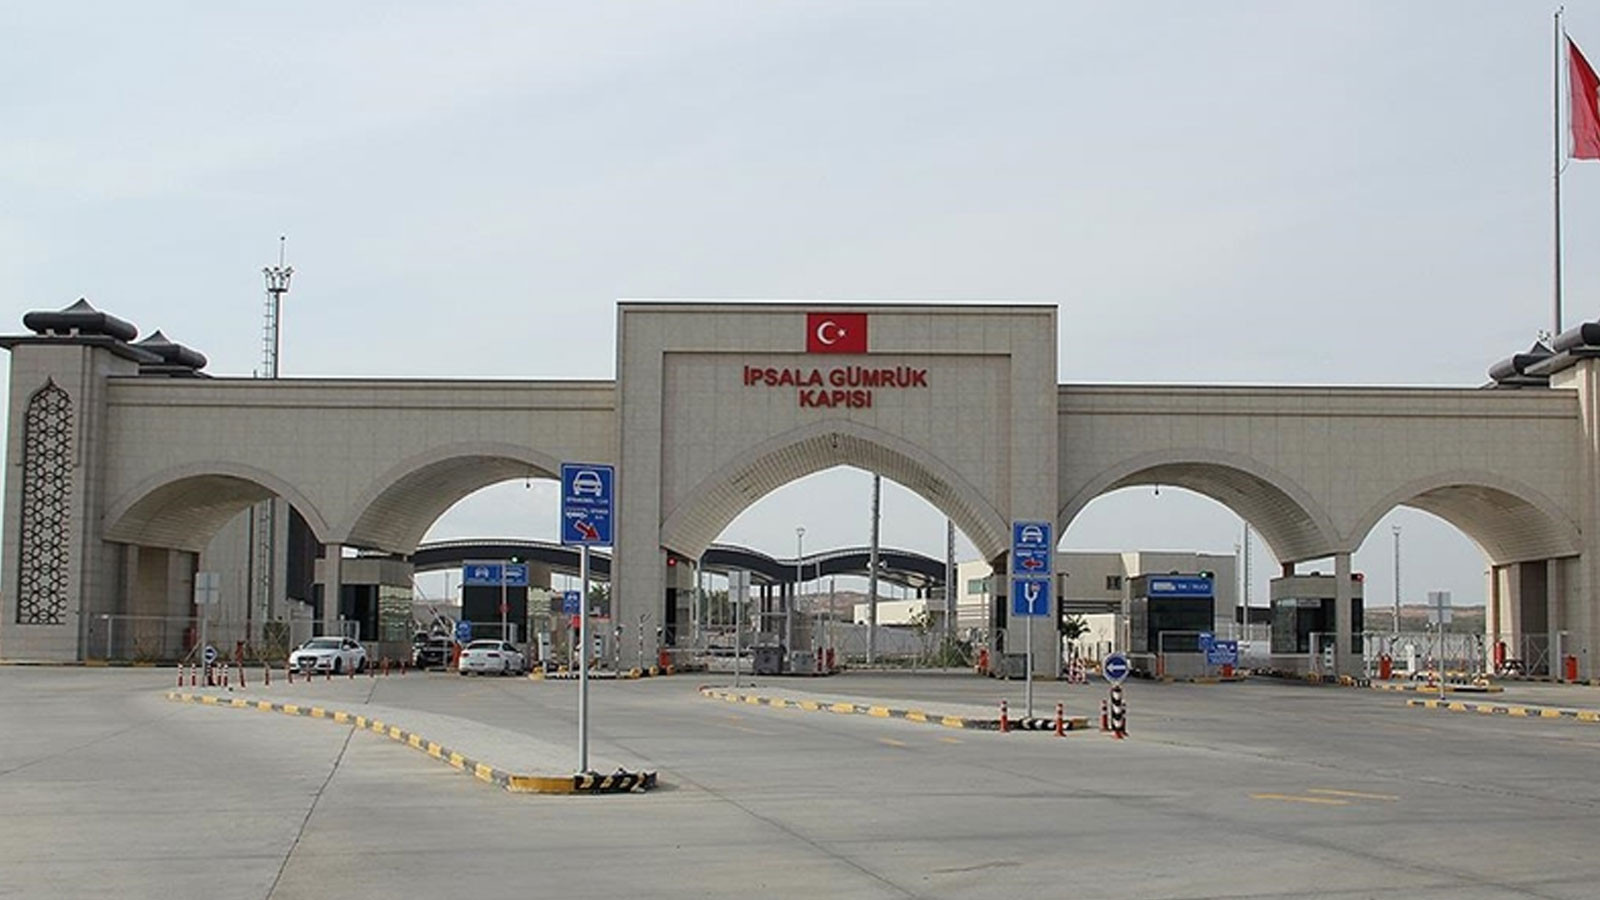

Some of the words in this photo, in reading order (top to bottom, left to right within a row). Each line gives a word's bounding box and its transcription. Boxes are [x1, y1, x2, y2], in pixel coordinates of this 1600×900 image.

[743, 365, 823, 386] İPSALA
[829, 366, 927, 387] GÜMRÜK
[799, 390, 872, 408] KAPISI
